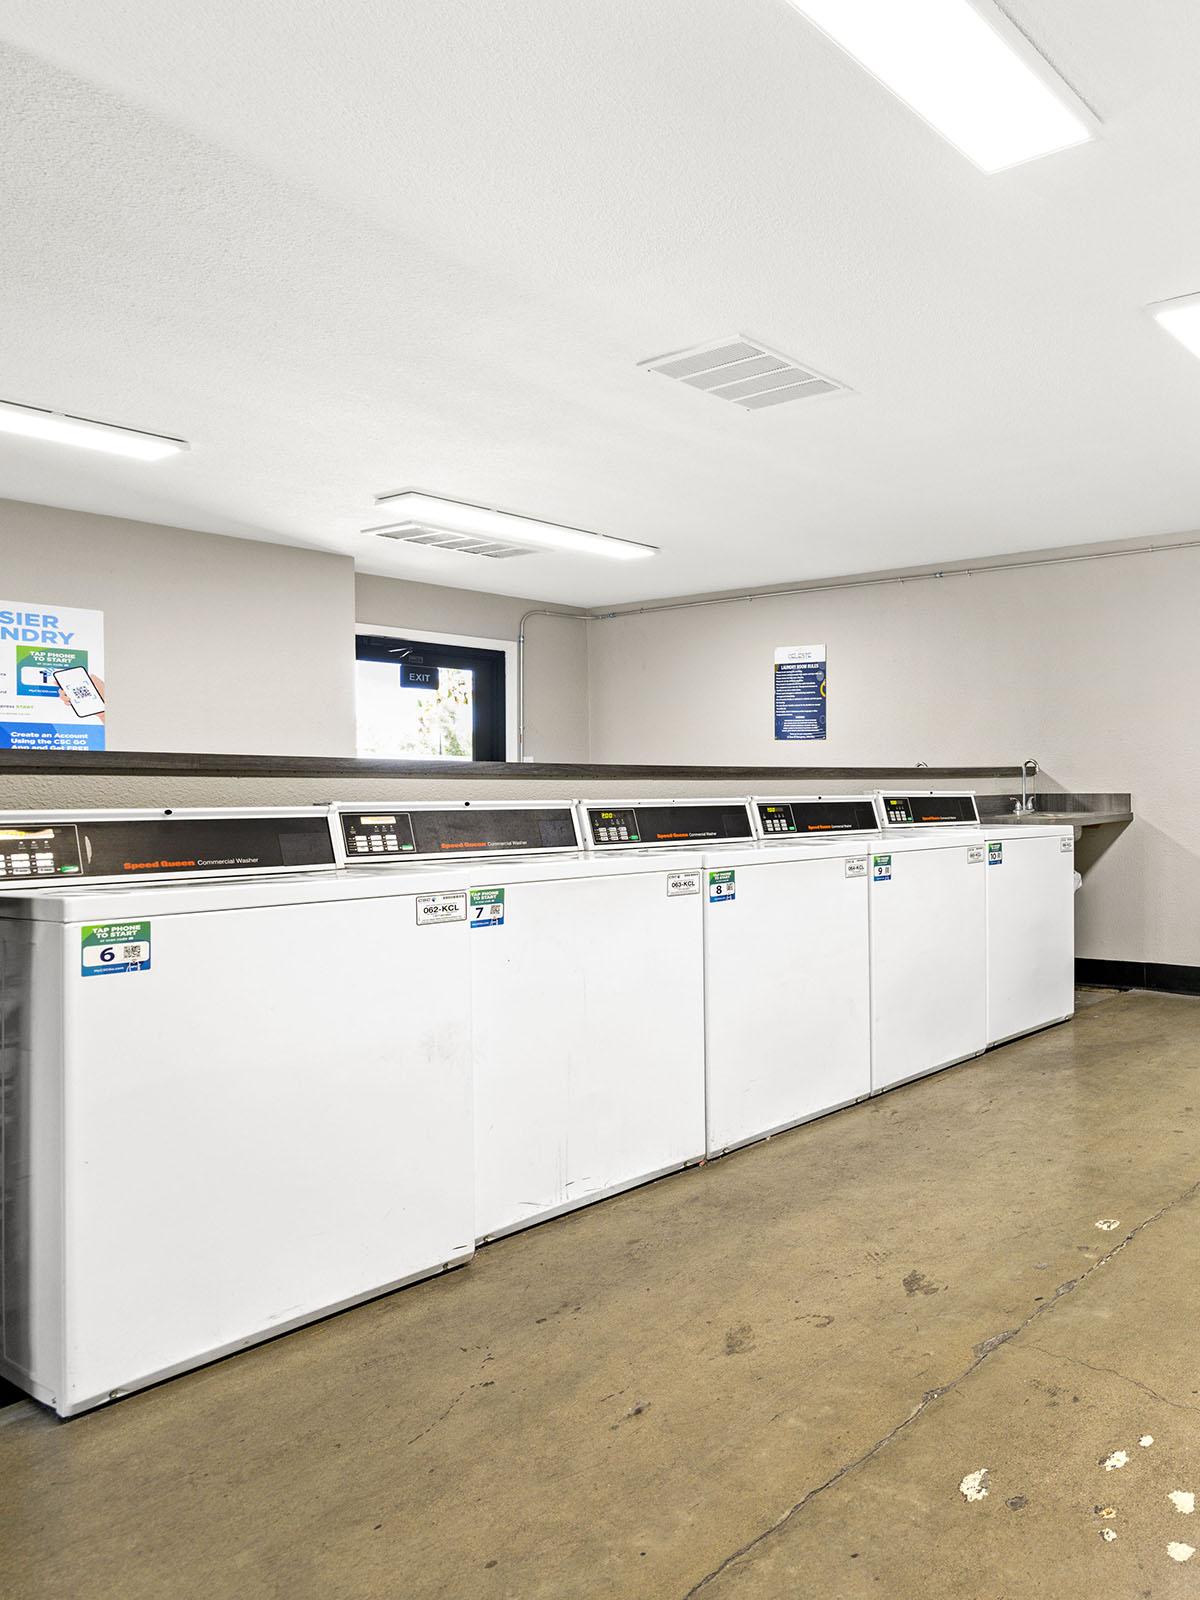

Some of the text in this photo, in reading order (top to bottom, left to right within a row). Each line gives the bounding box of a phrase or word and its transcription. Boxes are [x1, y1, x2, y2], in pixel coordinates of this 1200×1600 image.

[409, 673, 430, 682] EXIT
[124, 860, 160, 870] Speed
[161, 859, 195, 869] Queen
[197, 858, 235, 866] Commercial
[878, 867, 883, 875] 9
[716, 885, 722, 894] 8
[423, 904, 459, 914] 062-KCL
[476, 907, 483, 918] 7
[100, 947, 115, 962] 6
